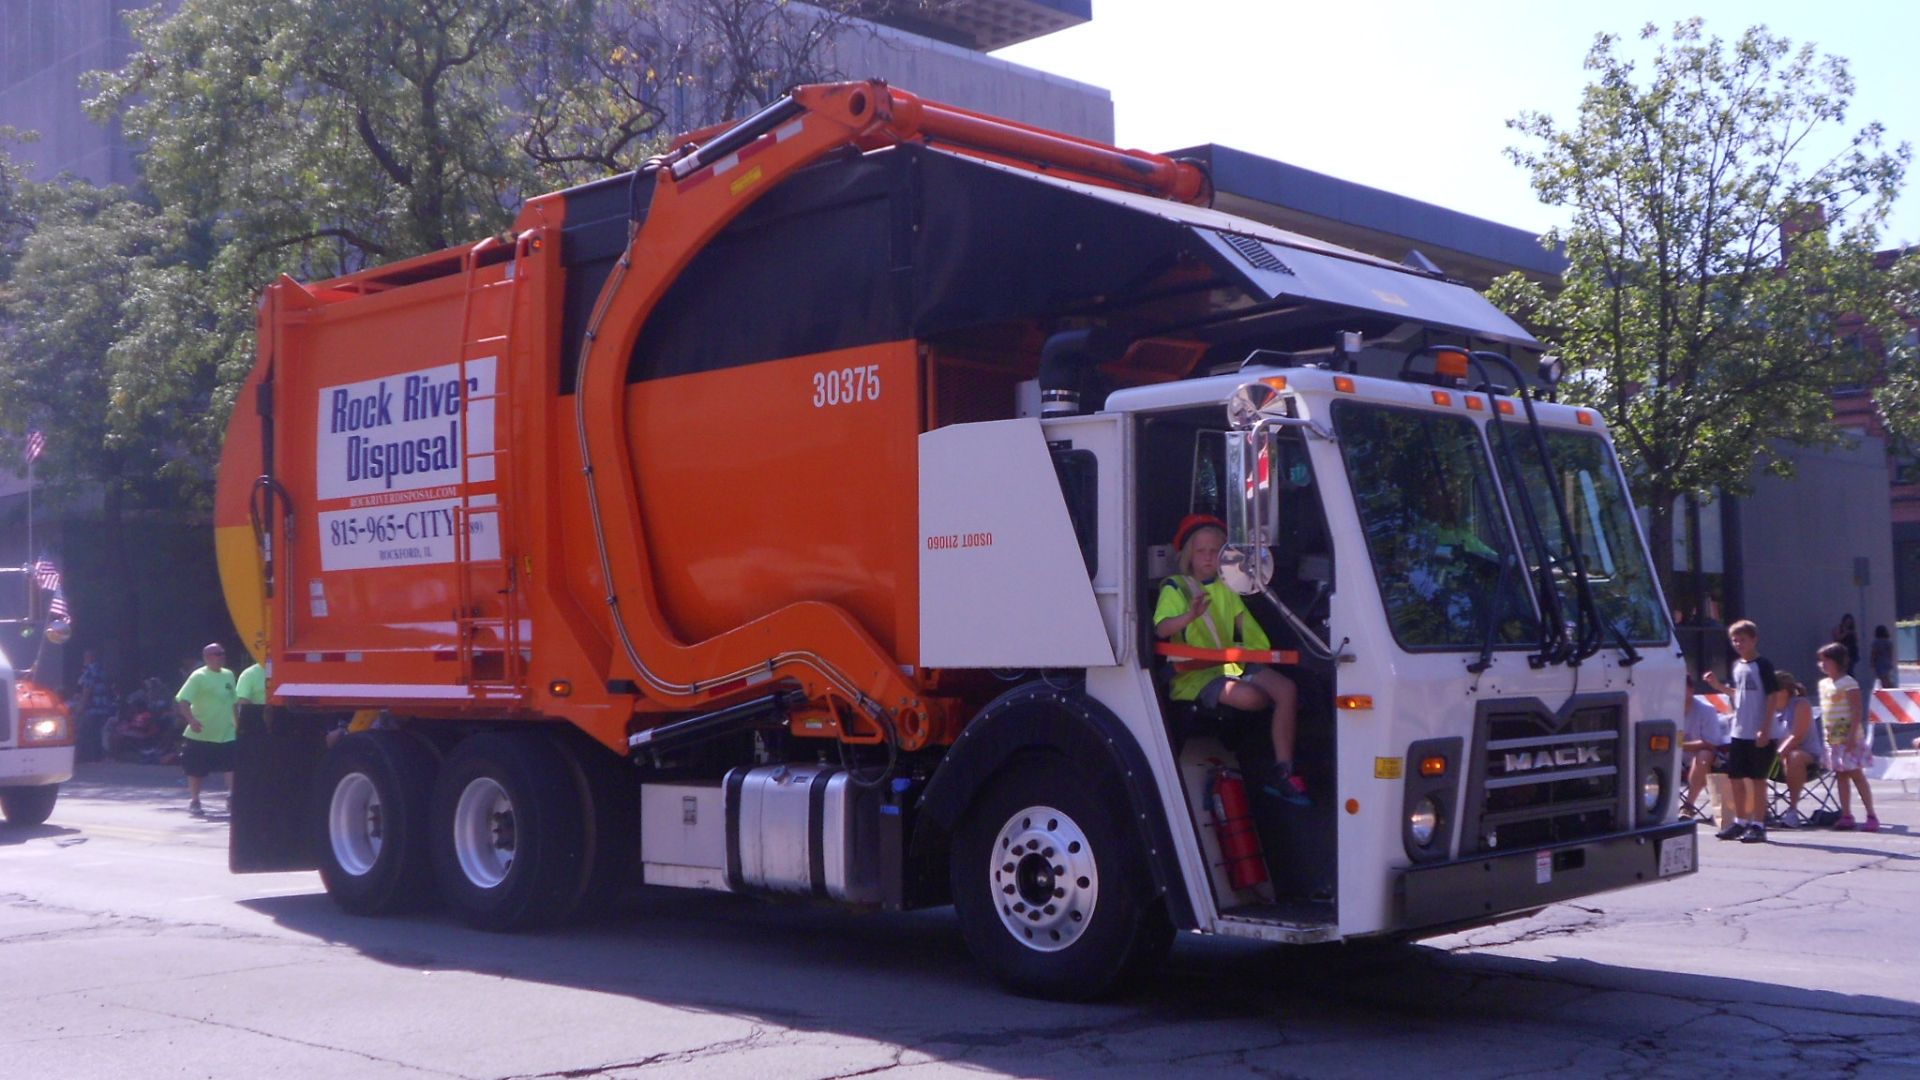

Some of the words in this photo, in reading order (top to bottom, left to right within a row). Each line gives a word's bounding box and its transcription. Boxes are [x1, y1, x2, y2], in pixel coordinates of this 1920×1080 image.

[813, 364, 880, 408] 30375
[331, 381, 392, 434] Rock
[403, 375, 478, 422] River
[346, 420, 458, 489] Disposal
[350, 486, 457, 508] ROCKRIVERDISPOSAL.COM
[331, 509, 454, 546] 815-965-CITY
[927, 535, 958, 550] 211060
[962, 532, 992, 548] USDOT
[379, 548, 421, 561] ROCKFORD,
[1505, 747, 1600, 771] MACK
